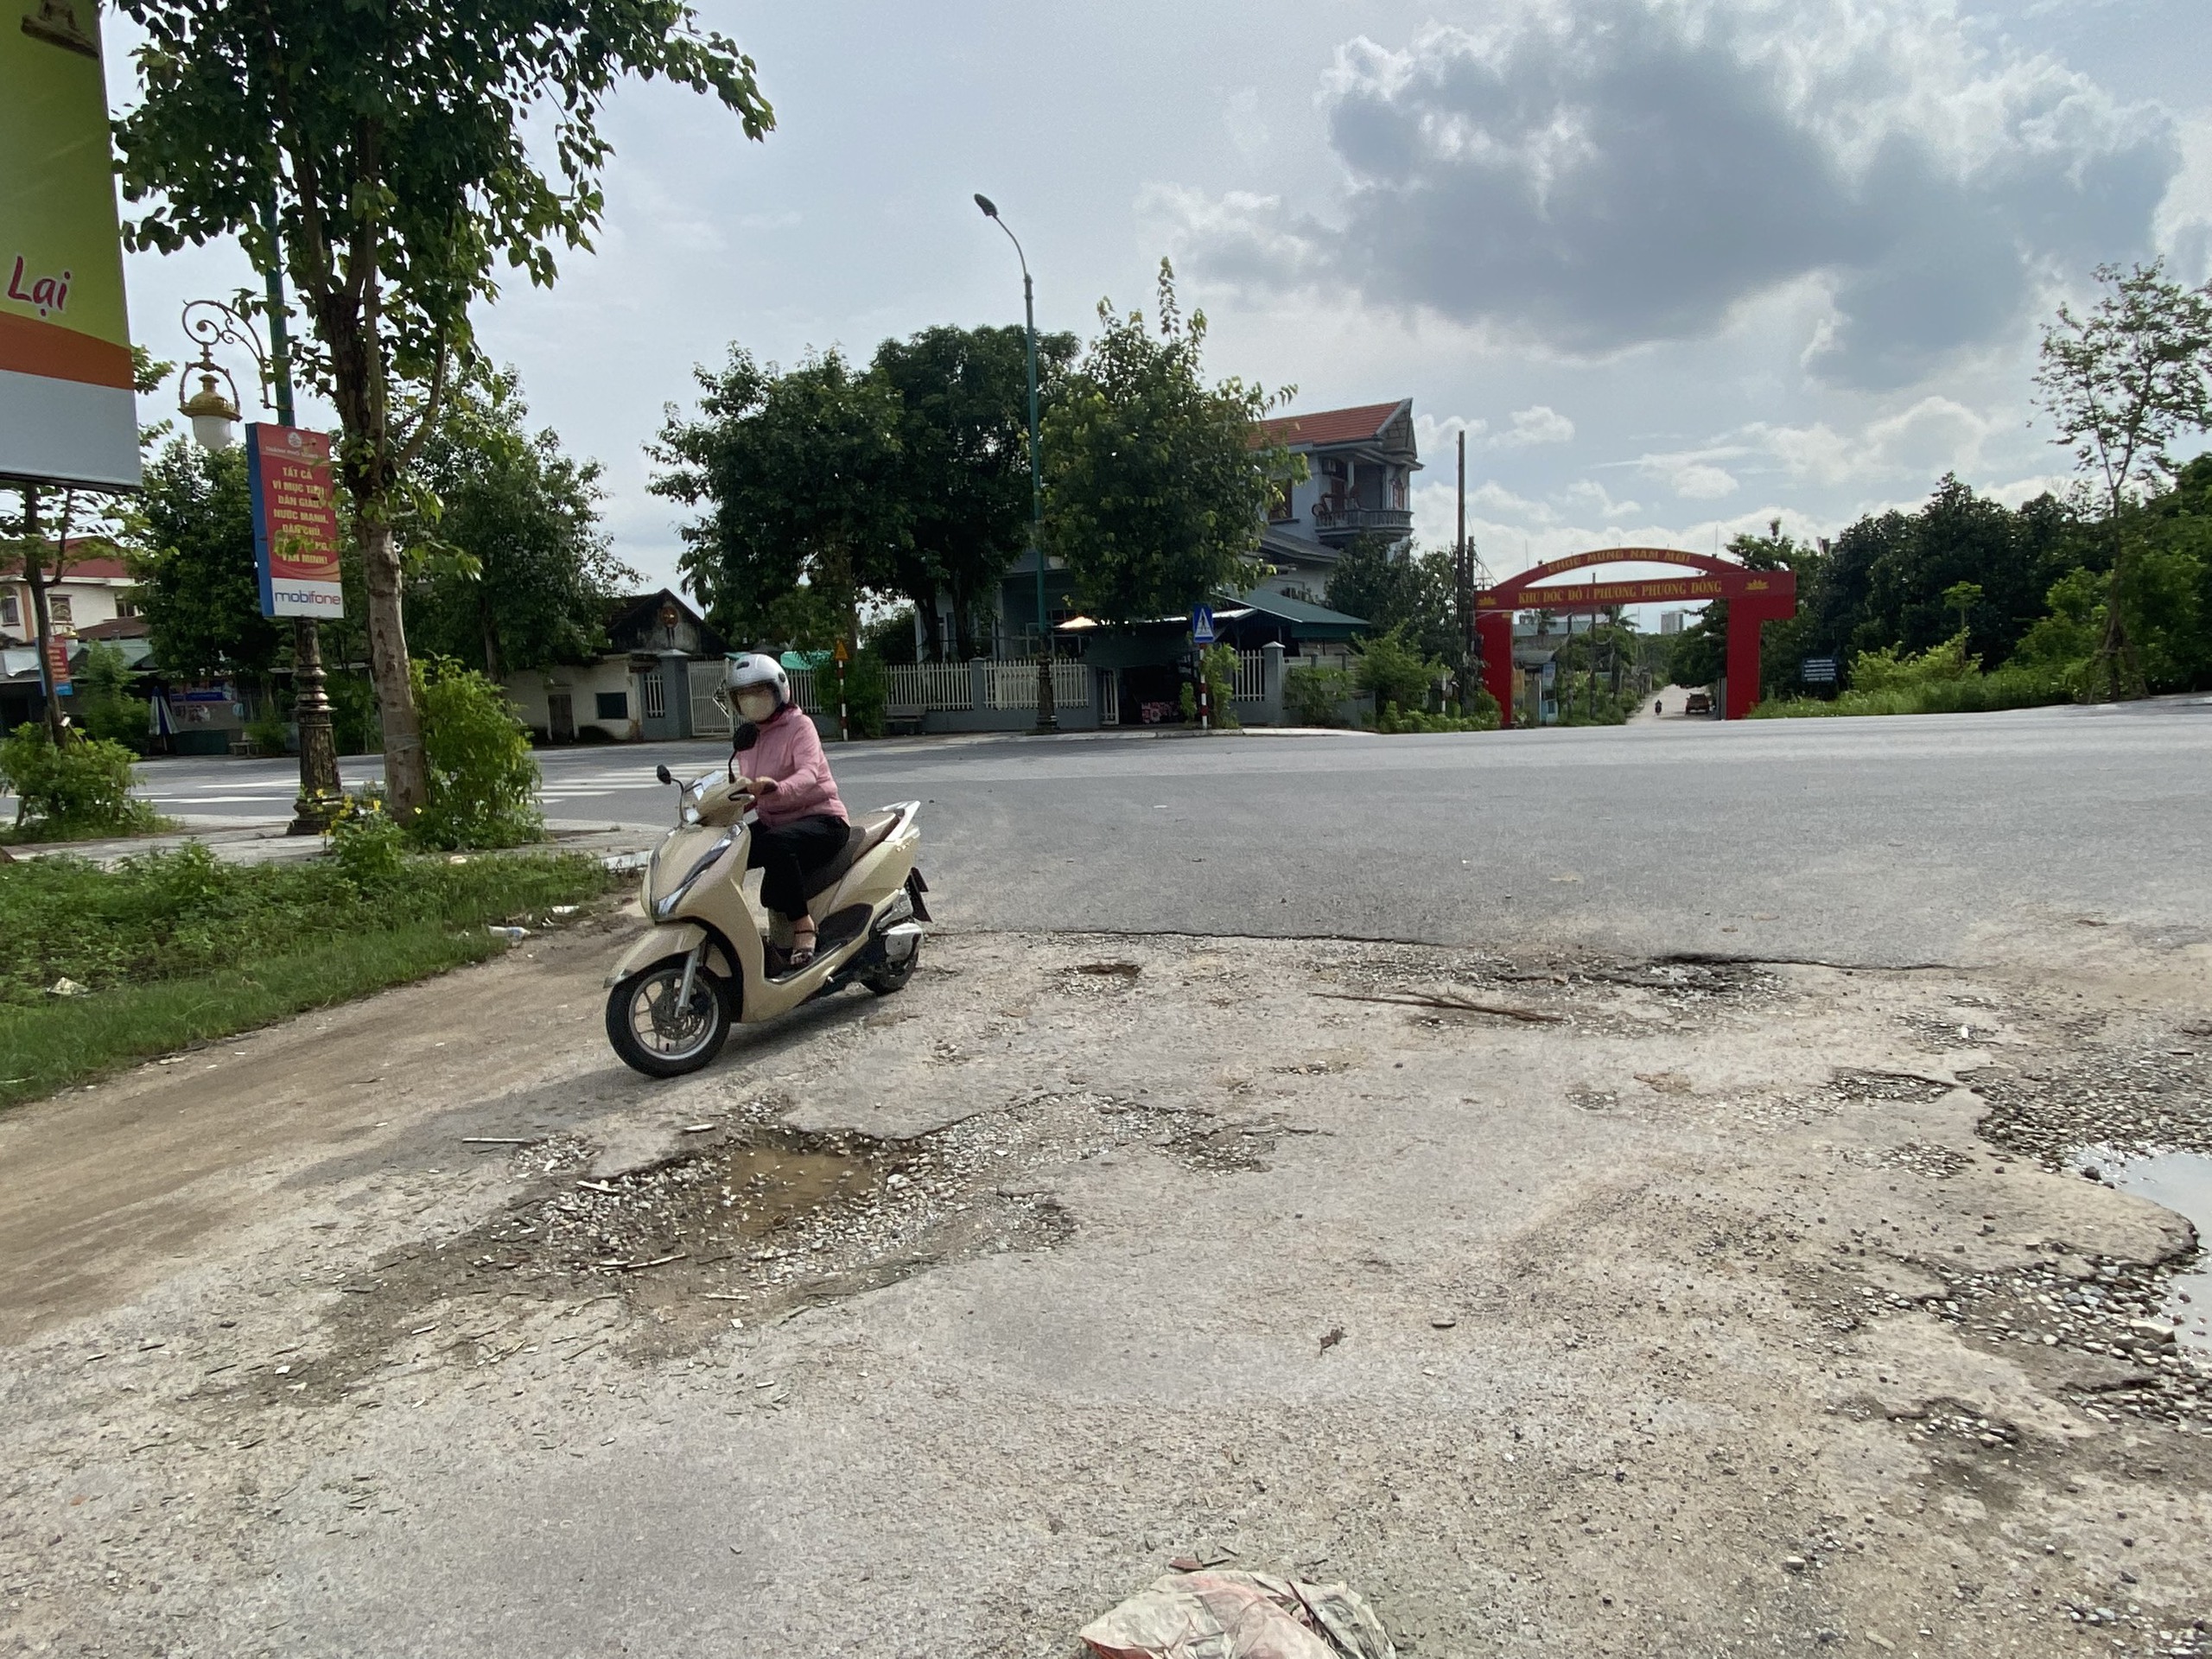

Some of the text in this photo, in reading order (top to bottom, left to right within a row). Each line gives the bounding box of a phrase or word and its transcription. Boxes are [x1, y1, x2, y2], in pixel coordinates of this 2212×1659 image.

[8, 255, 71, 317] Lại
[283, 466, 313, 480] TẤT CẢ
[272, 479, 282, 490] VÌ
[283, 482, 303, 493] MỤC
[277, 494, 296, 505] DÂN
[273, 508, 329, 524] NƯỚC MẠNH,
[275, 590, 340, 605] mobifone
[1518, 591, 1539, 605] KHU
